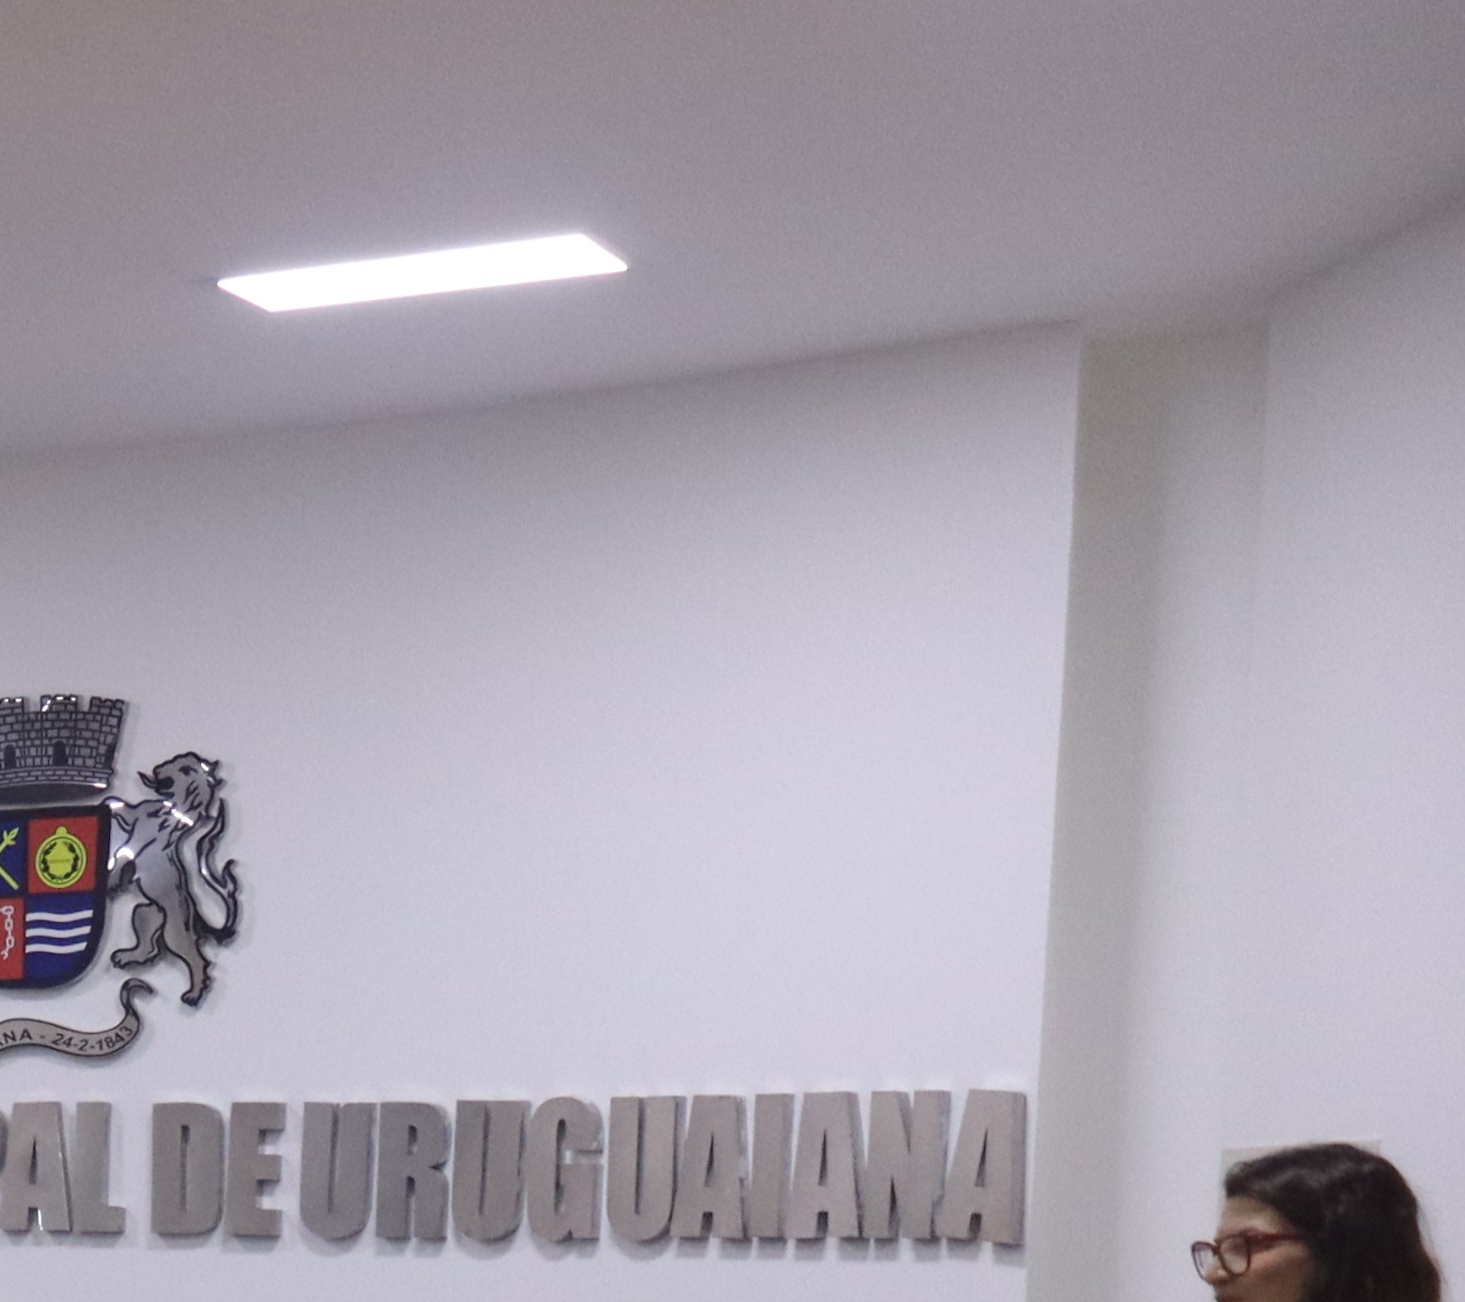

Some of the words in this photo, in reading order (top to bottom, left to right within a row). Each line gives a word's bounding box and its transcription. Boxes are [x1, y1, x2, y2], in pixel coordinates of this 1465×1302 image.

[52, 1025, 133, 1051] 24-2-1843
[151, 1101, 287, 1239] DE
[300, 1090, 1027, 1244] URUGUAIANA
